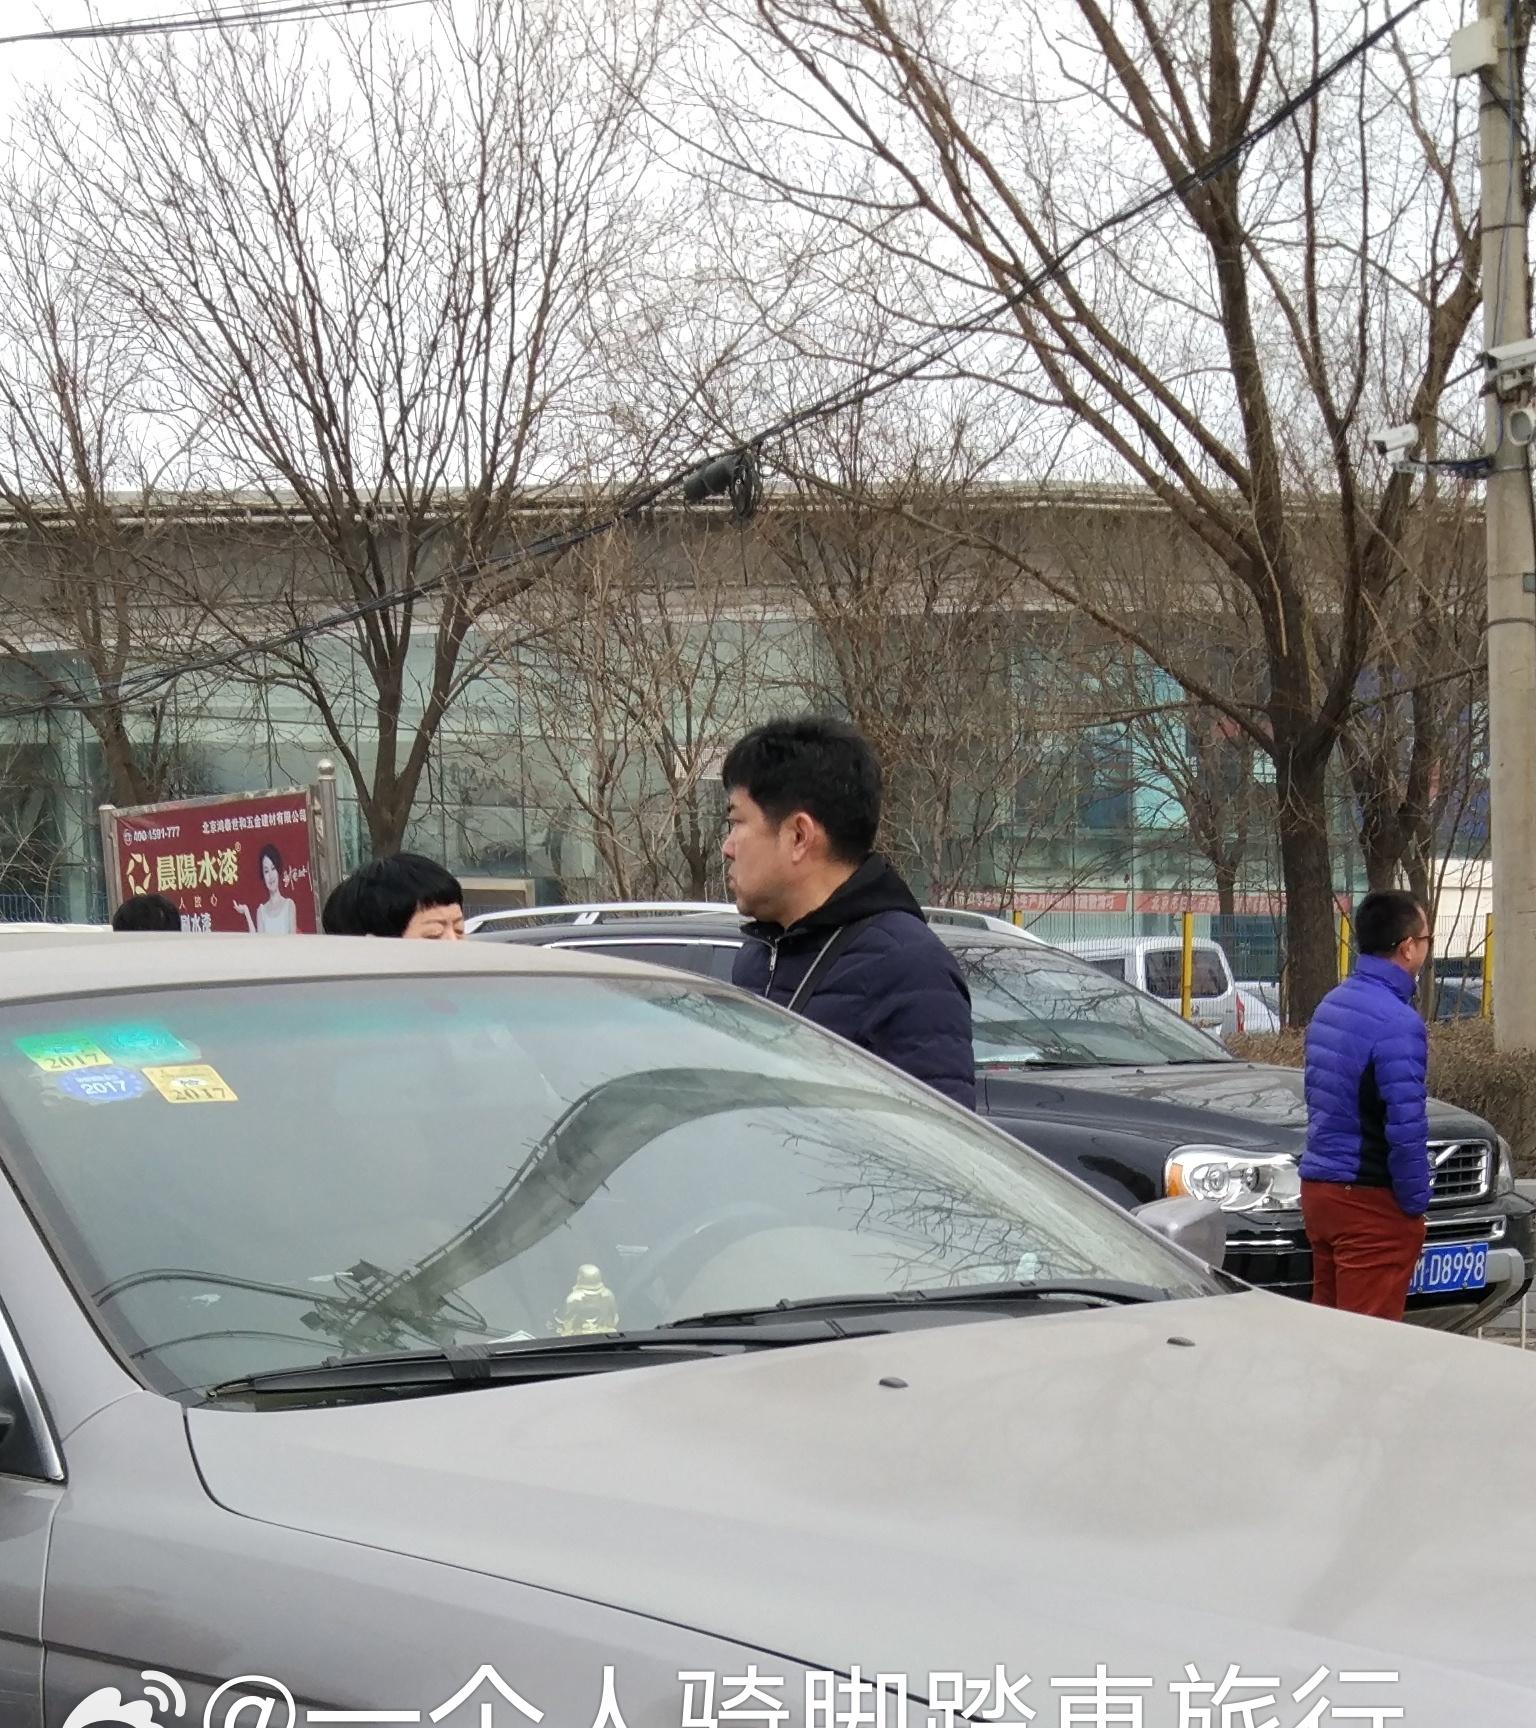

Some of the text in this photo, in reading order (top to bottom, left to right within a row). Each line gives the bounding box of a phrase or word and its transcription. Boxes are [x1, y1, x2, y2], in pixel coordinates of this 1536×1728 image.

[156, 848, 239, 891] 晨陽水漆
[44, 1052, 100, 1070] 2017
[80, 1079, 127, 1095] 2017
[174, 1087, 227, 1101] 2017
